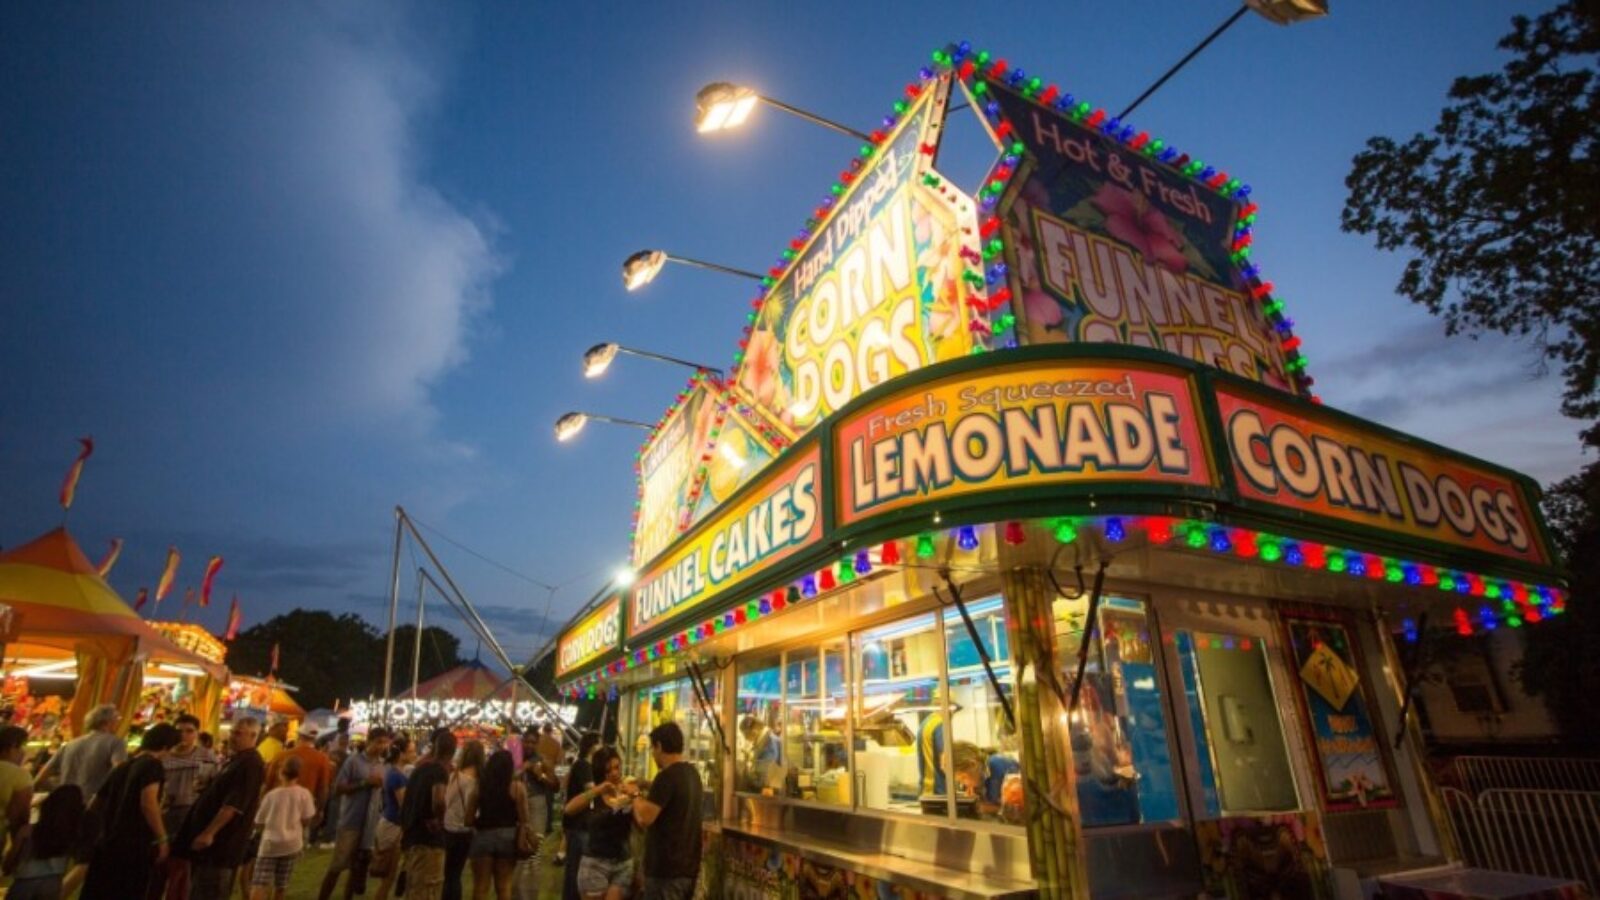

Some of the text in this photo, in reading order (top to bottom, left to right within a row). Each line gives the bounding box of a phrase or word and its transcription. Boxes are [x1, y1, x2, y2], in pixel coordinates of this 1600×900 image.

[794, 148, 898, 299] Hand Dipped
[1031, 112, 1213, 224] Hot & Fresh
[787, 188, 912, 360] CORN
[1037, 215, 1268, 356] FUNNEL
[794, 297, 922, 418] DOGS
[867, 375, 1137, 438] Fresh Squeezed
[850, 391, 1189, 512] LEMONADE
[1228, 409, 1530, 551] CORN DOGS
[633, 547, 706, 629] FUNNEL
[708, 462, 819, 585] CAKES
